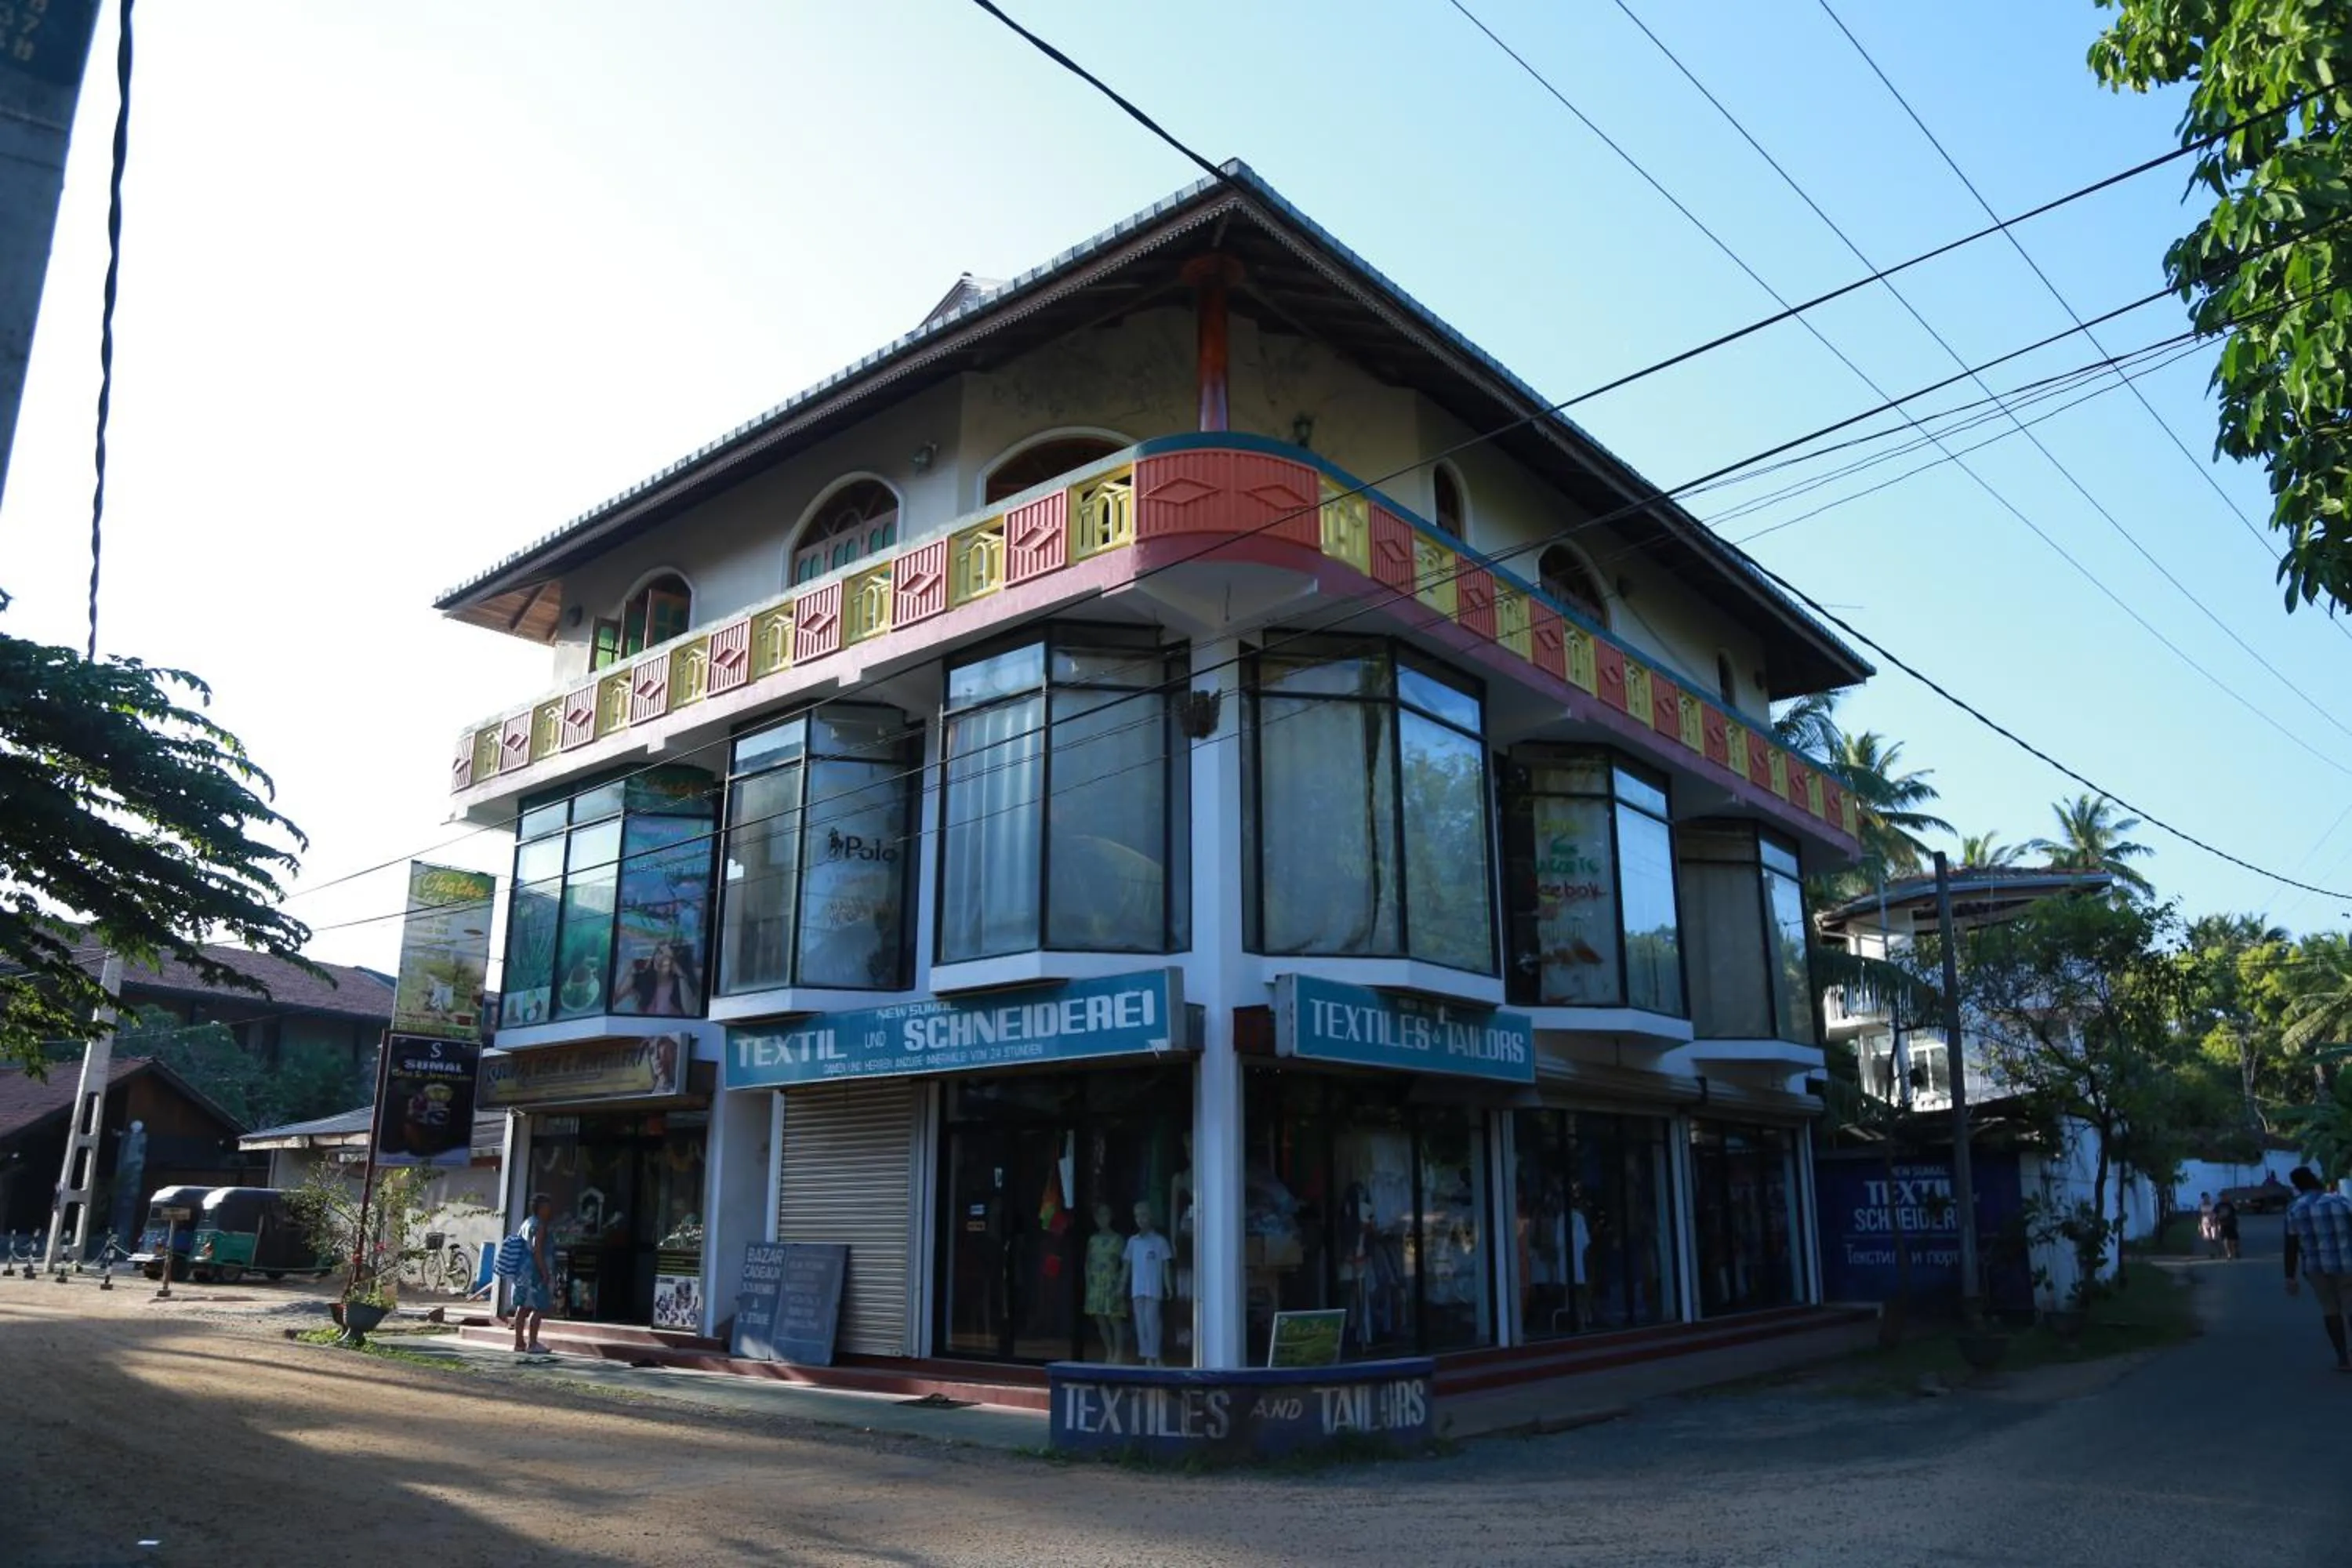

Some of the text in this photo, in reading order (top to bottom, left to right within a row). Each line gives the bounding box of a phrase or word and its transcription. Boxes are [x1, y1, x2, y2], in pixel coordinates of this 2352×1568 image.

[844, 835, 898, 863] Polo
[876, 1007, 909, 1019] NEW
[733, 989, 1156, 1068] TEXTIL UND SCHNEIDEREI
[1309, 998, 1430, 1051] TEXTILES
[1445, 1020, 1526, 1065] TAILORS
[404, 1058, 464, 1073] SUMAL
[971, 1049, 988, 1062] VON
[1004, 1044, 1043, 1058] STUNDEN
[1060, 1378, 1427, 1441] TEXTILES AND TAILORS
